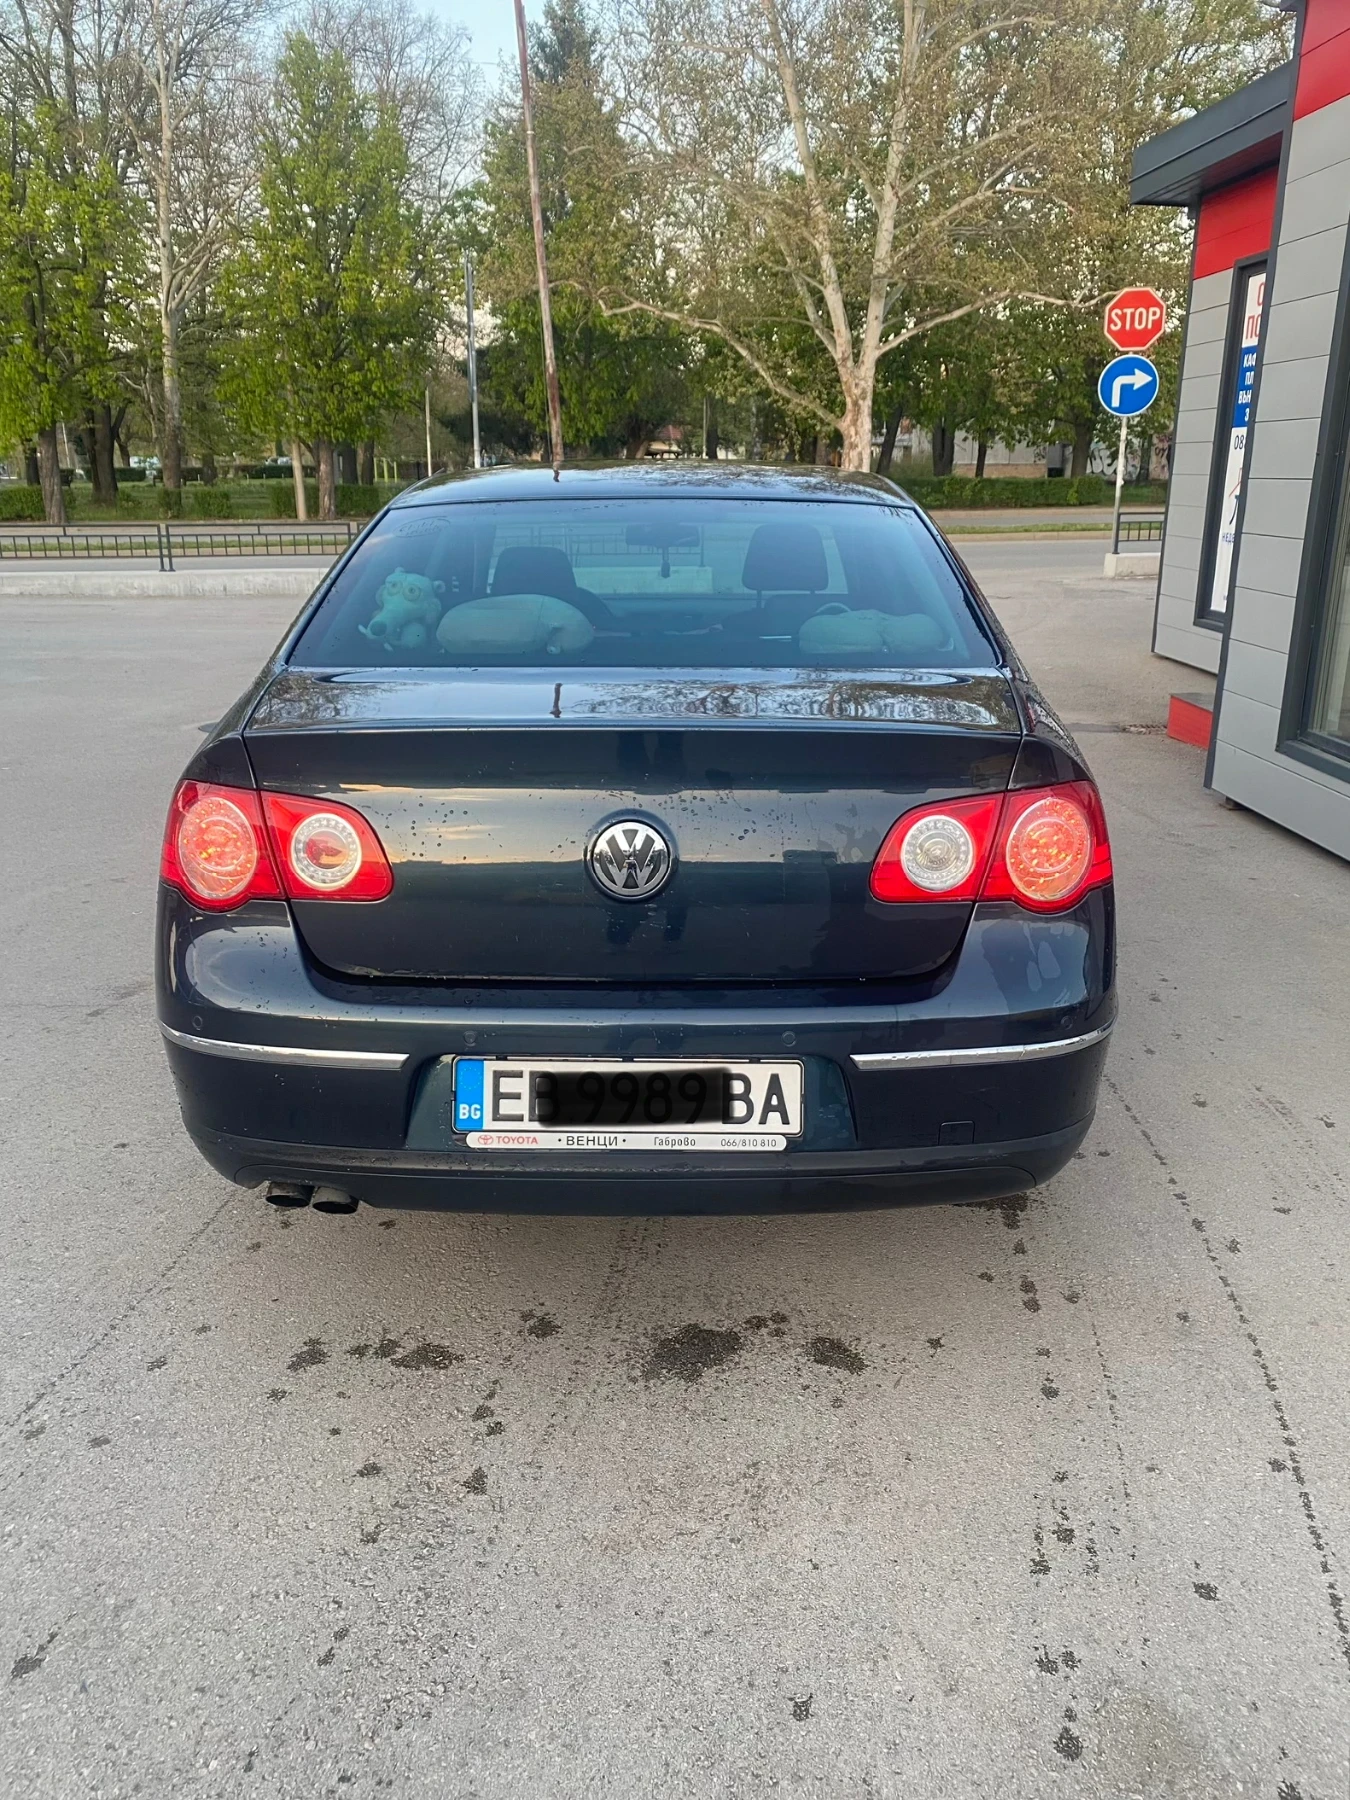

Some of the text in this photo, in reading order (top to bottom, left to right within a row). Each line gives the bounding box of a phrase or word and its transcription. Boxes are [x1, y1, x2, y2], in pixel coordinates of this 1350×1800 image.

[1110, 307, 1160, 331] STOP
[721, 1072, 790, 1125] BA
[459, 1103, 481, 1120] BG
[495, 1136, 539, 1145] TOYOTA
[566, 1136, 618, 1148] ВЕНЦИ
[653, 1137, 696, 1148] Габрово
